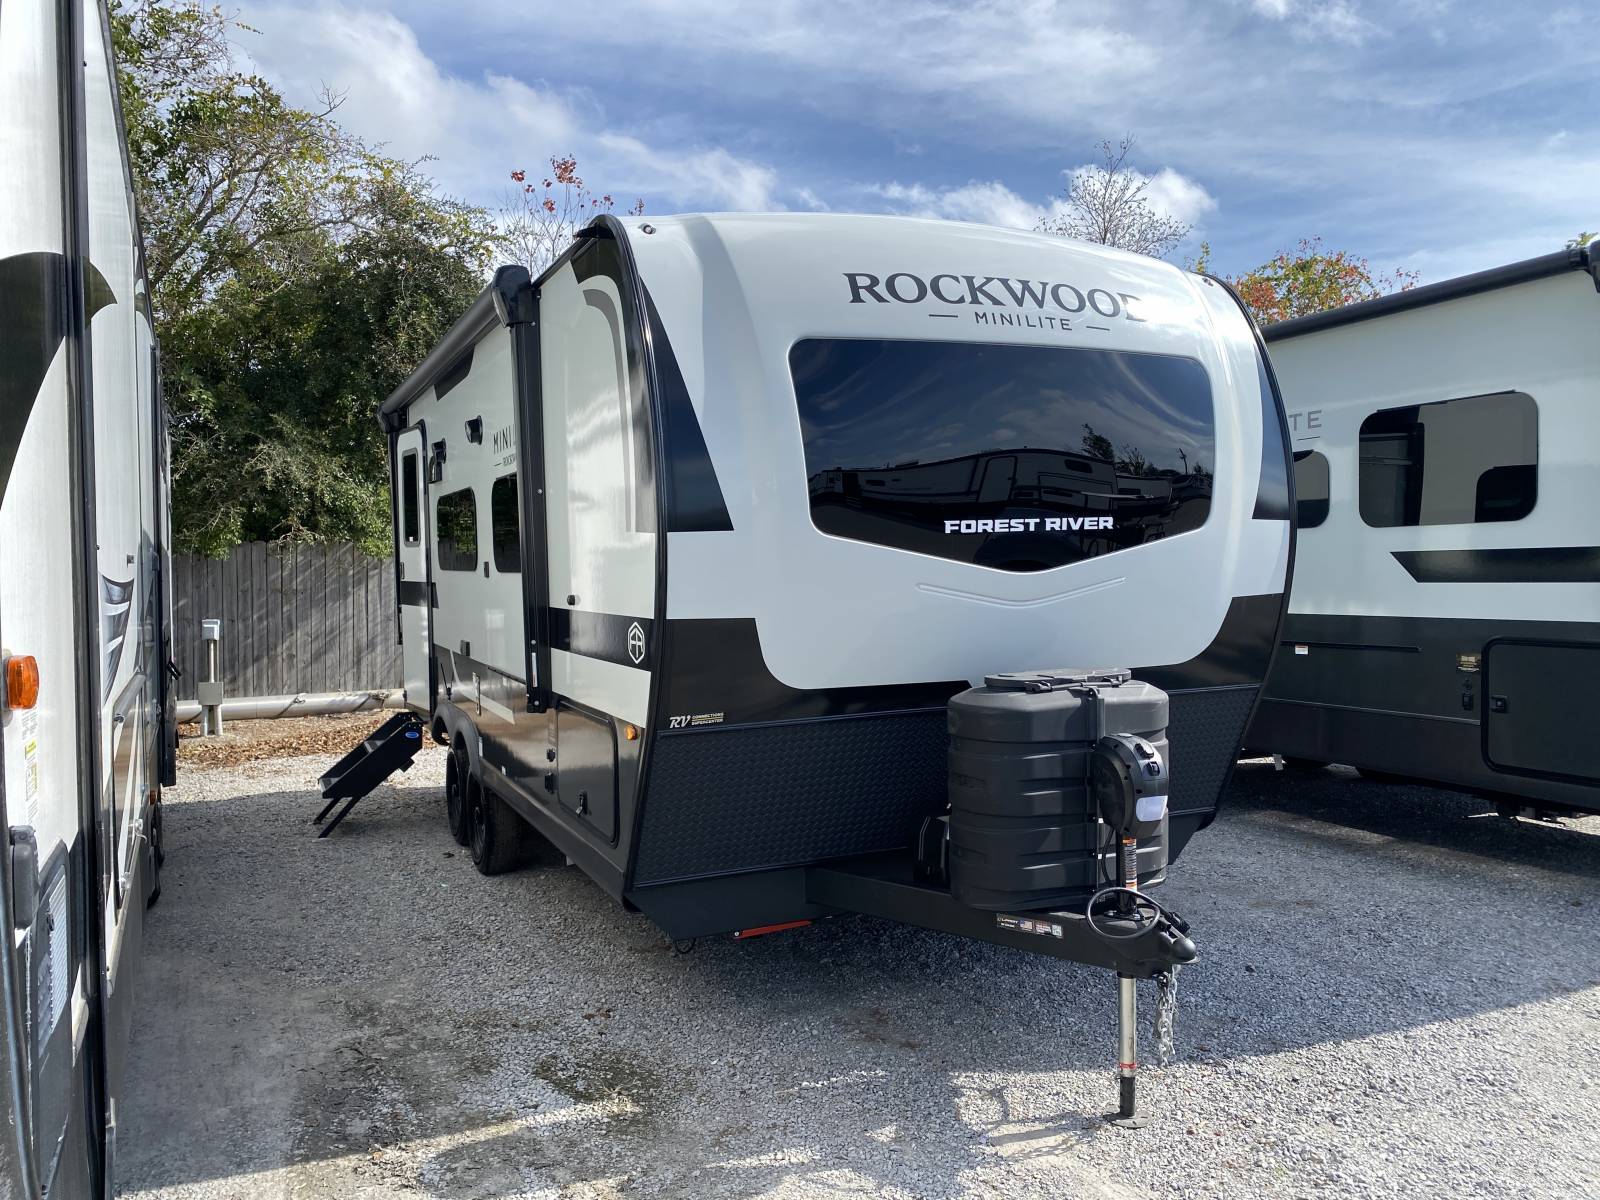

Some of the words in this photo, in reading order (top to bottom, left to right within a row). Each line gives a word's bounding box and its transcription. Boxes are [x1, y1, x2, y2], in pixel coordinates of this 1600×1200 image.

[975, 311, 1072, 331] MINILITE
[944, 518, 1040, 534] FOREST
[1044, 516, 1114, 532] RIVER
[669, 715, 691, 729] RV
